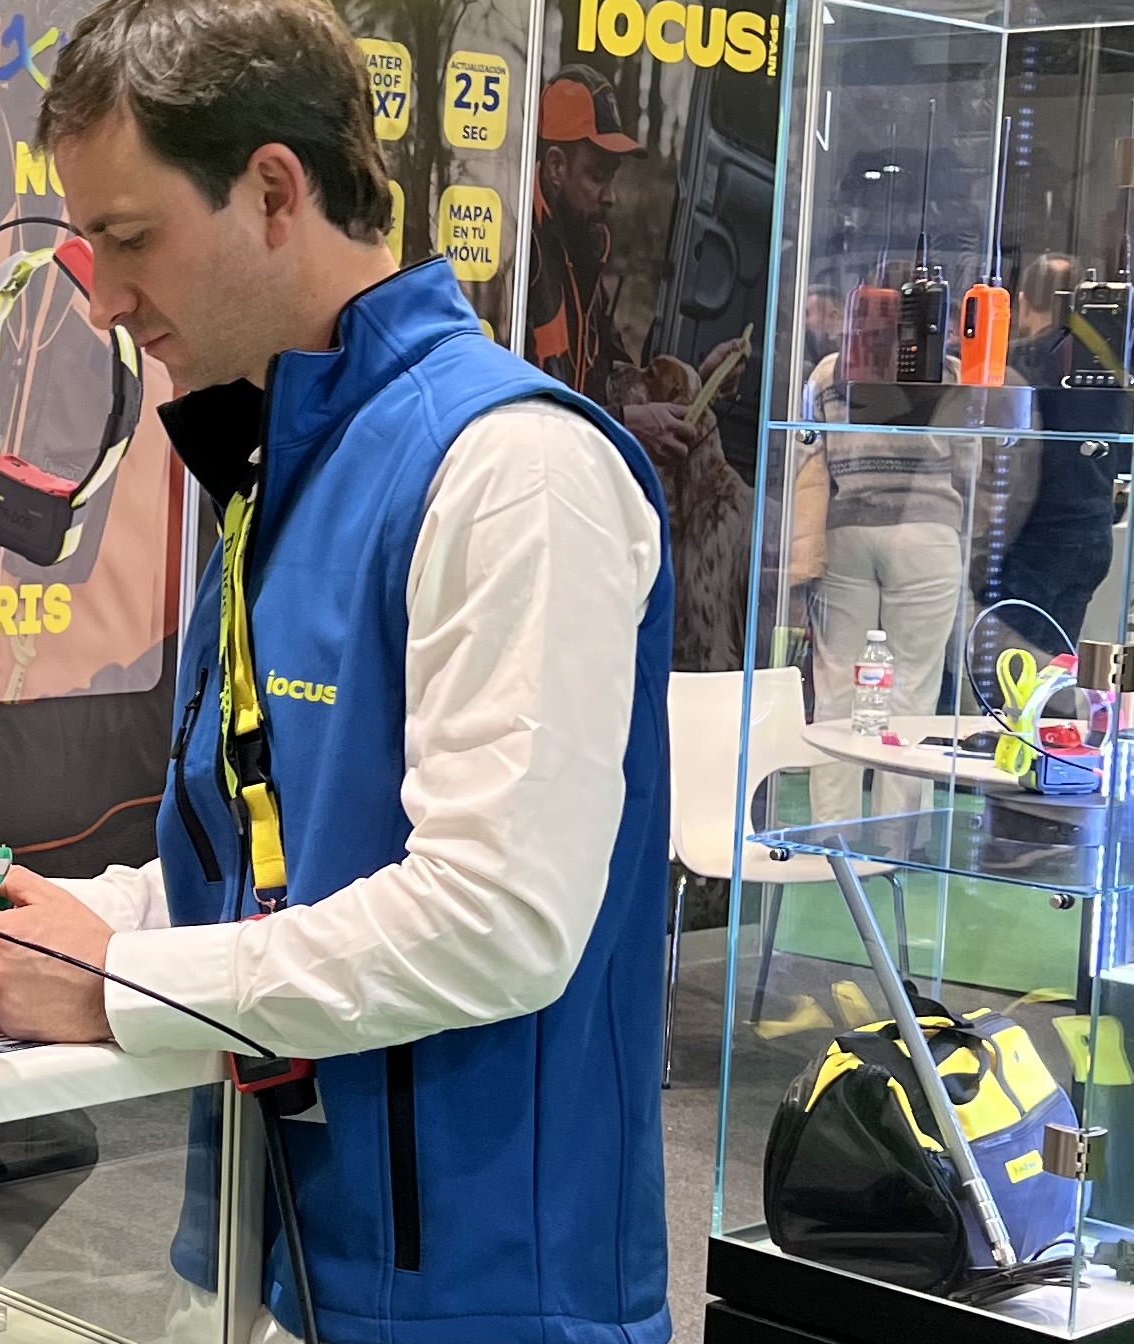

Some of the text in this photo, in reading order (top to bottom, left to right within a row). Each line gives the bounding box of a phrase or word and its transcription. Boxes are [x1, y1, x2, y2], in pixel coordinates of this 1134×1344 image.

[766, 13, 780, 78] SPAIN
[366, 53, 402, 72] ATER
[450, 61, 507, 76] ACTUALIZACIÓN
[373, 72, 402, 89] OOF
[454, 73, 500, 117] 2,5
[374, 90, 407, 120] X7
[462, 125, 488, 142] SEG
[449, 204, 493, 223] MAPA
[453, 225, 468, 240] EN
[446, 242, 492, 264] MÓVIL
